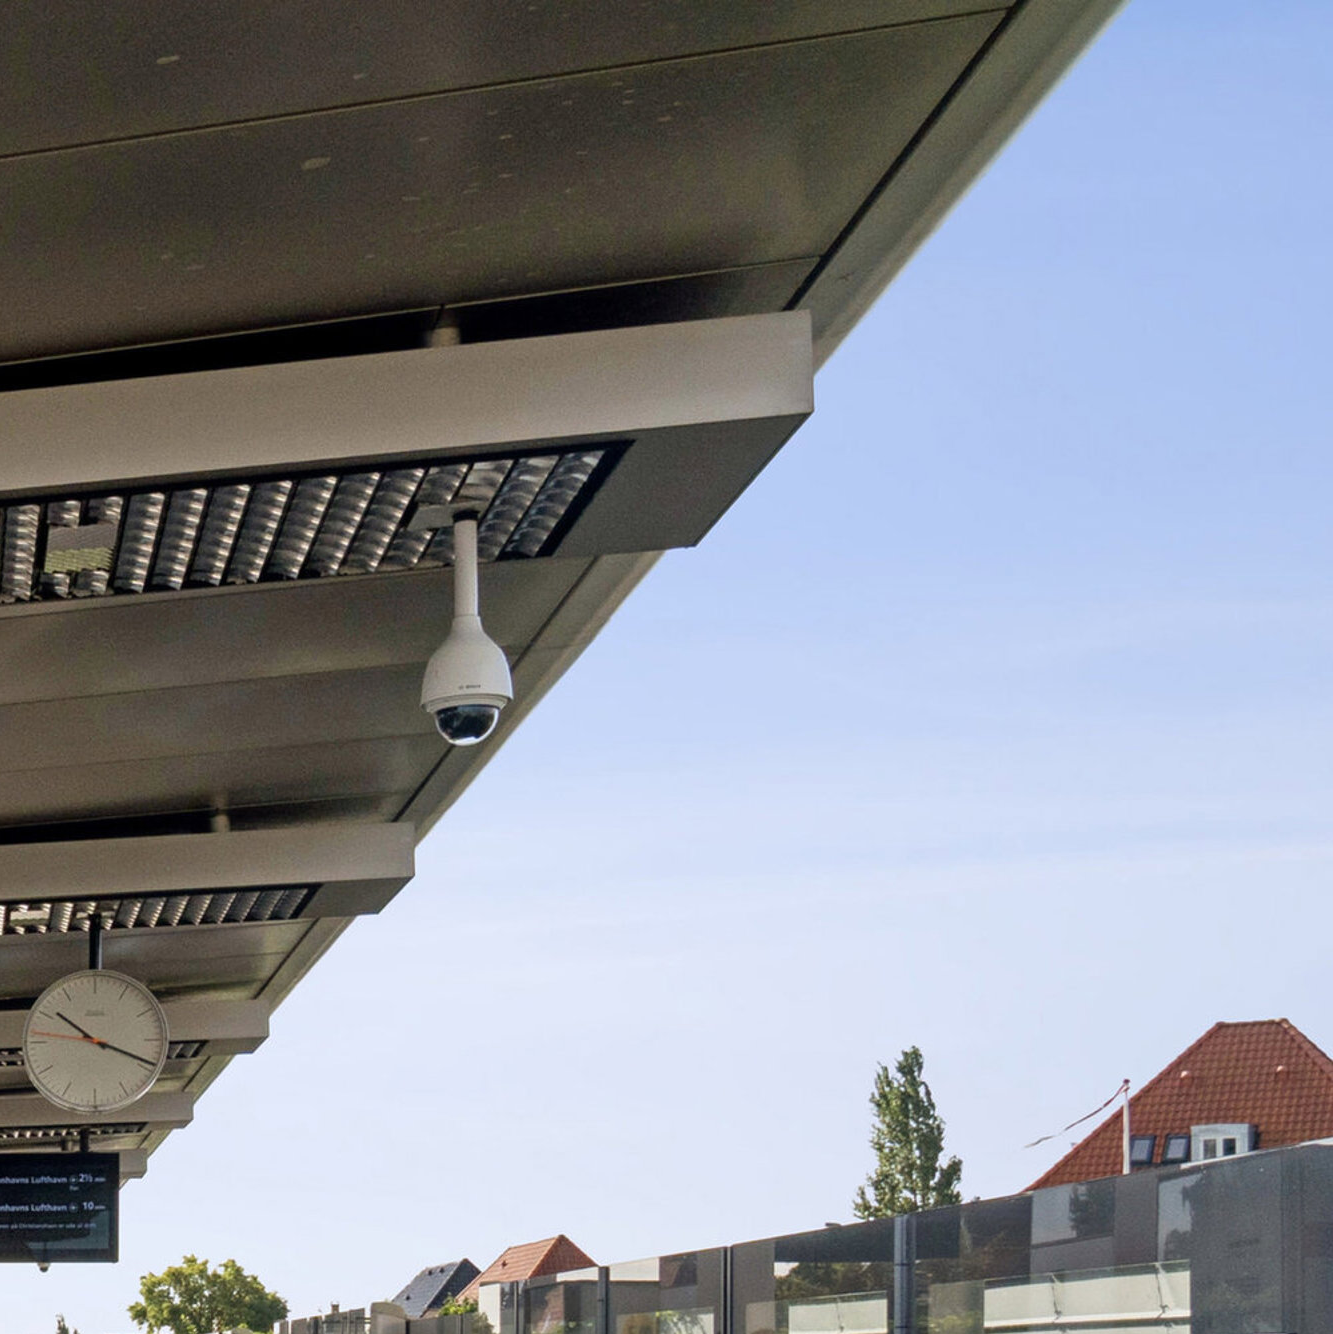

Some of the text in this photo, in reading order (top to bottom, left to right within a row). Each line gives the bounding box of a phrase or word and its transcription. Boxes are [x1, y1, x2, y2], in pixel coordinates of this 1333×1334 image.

[31, 1176, 67, 1184] Lufthavn
[31, 1203, 67, 1212] Lufthavn
[83, 1202, 95, 1211] 10
